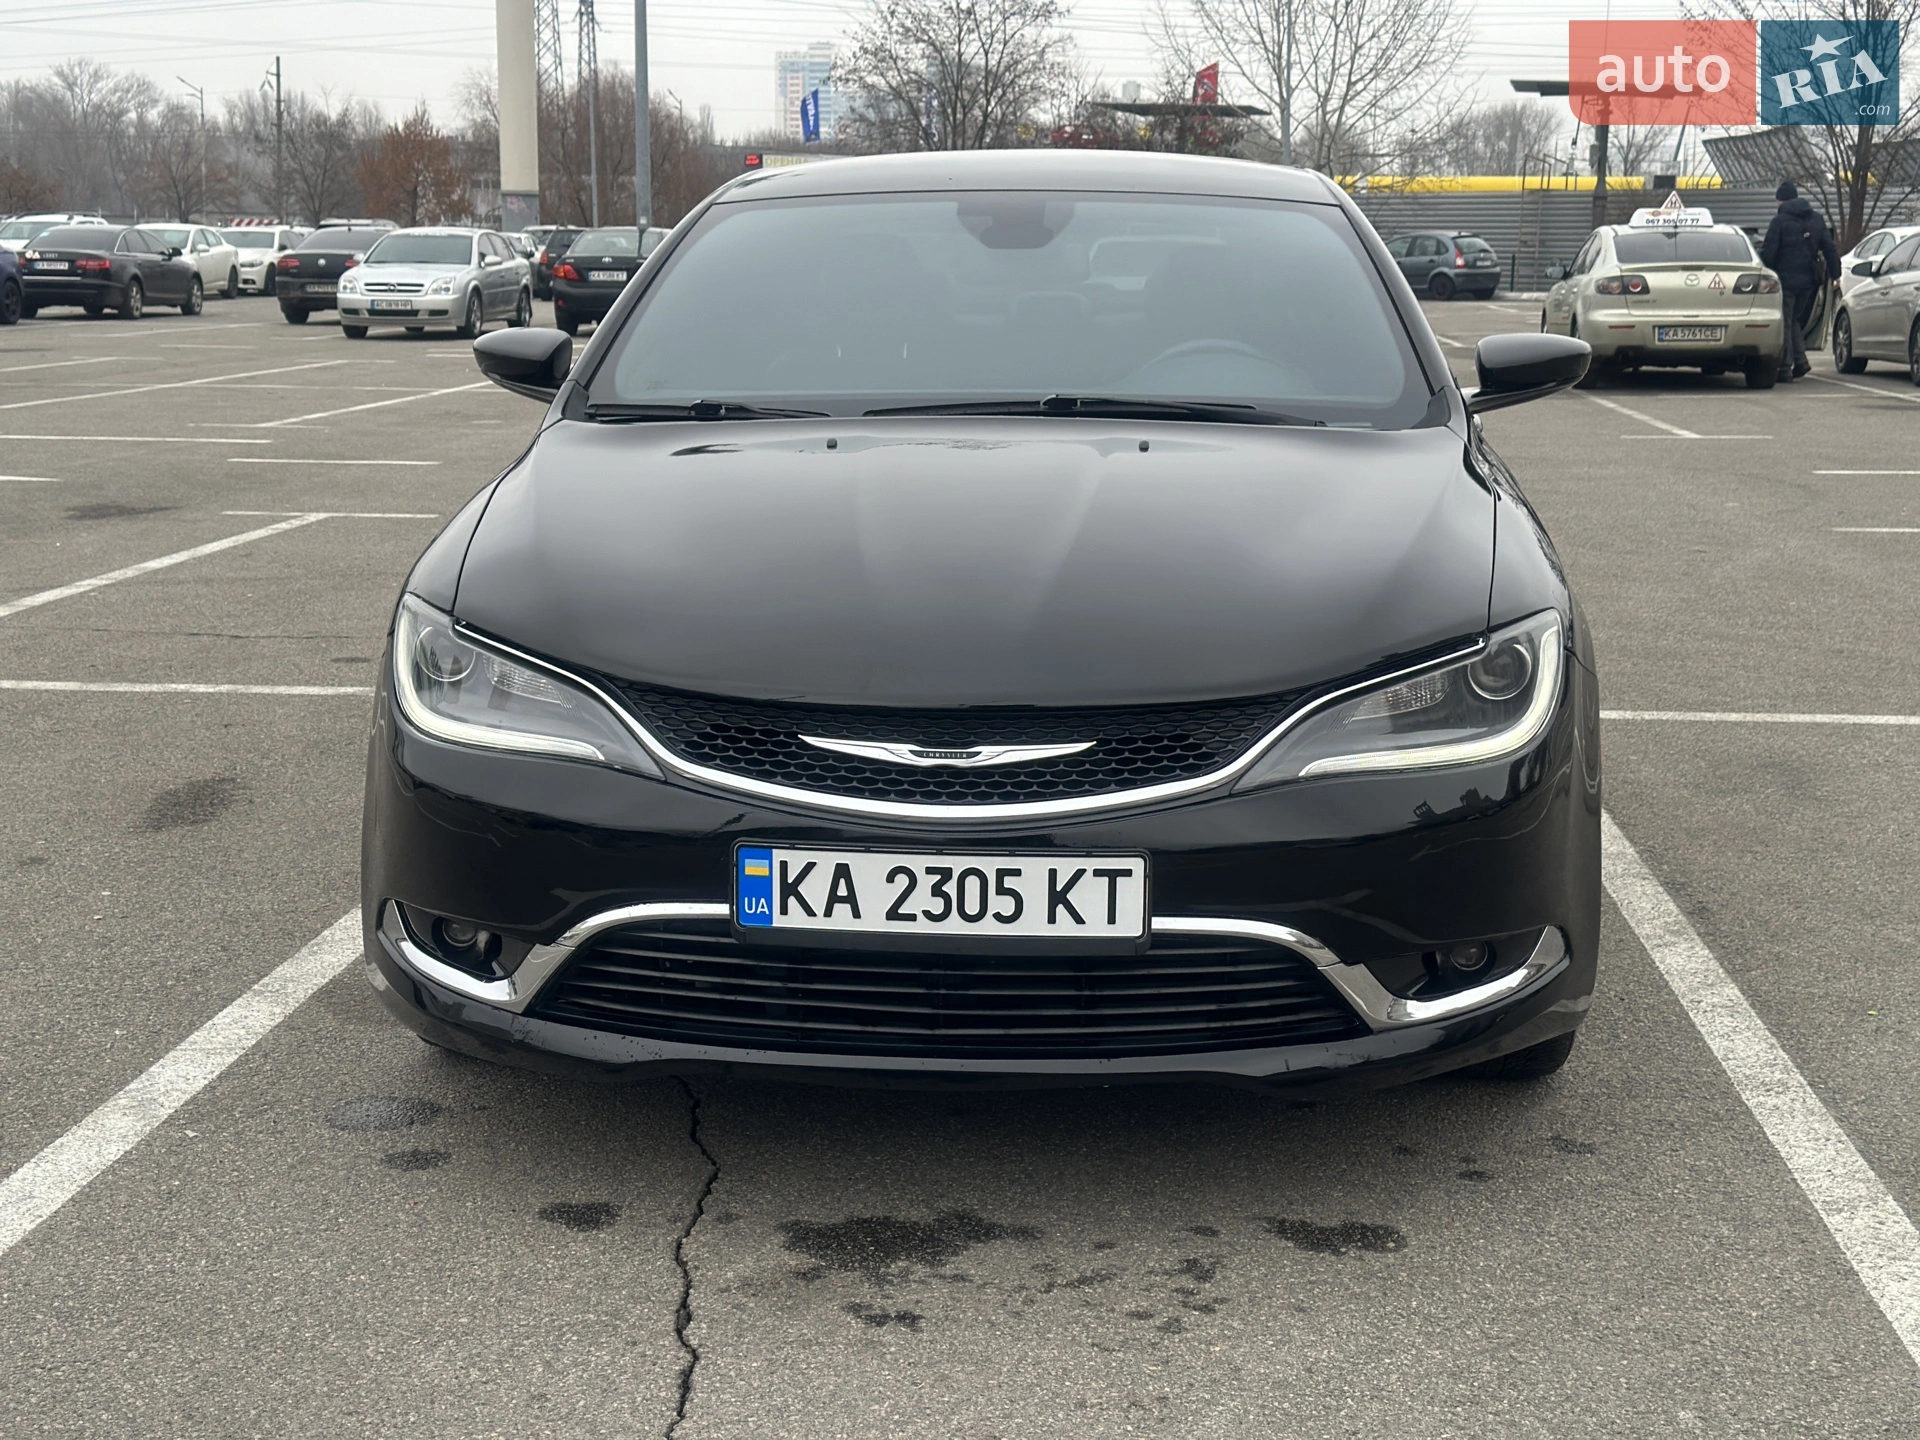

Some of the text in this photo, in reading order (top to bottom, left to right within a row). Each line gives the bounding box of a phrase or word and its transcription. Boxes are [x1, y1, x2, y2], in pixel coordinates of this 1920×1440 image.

[744, 897, 769, 914] UA
[778, 860, 1133, 925] KA 2305 KT
